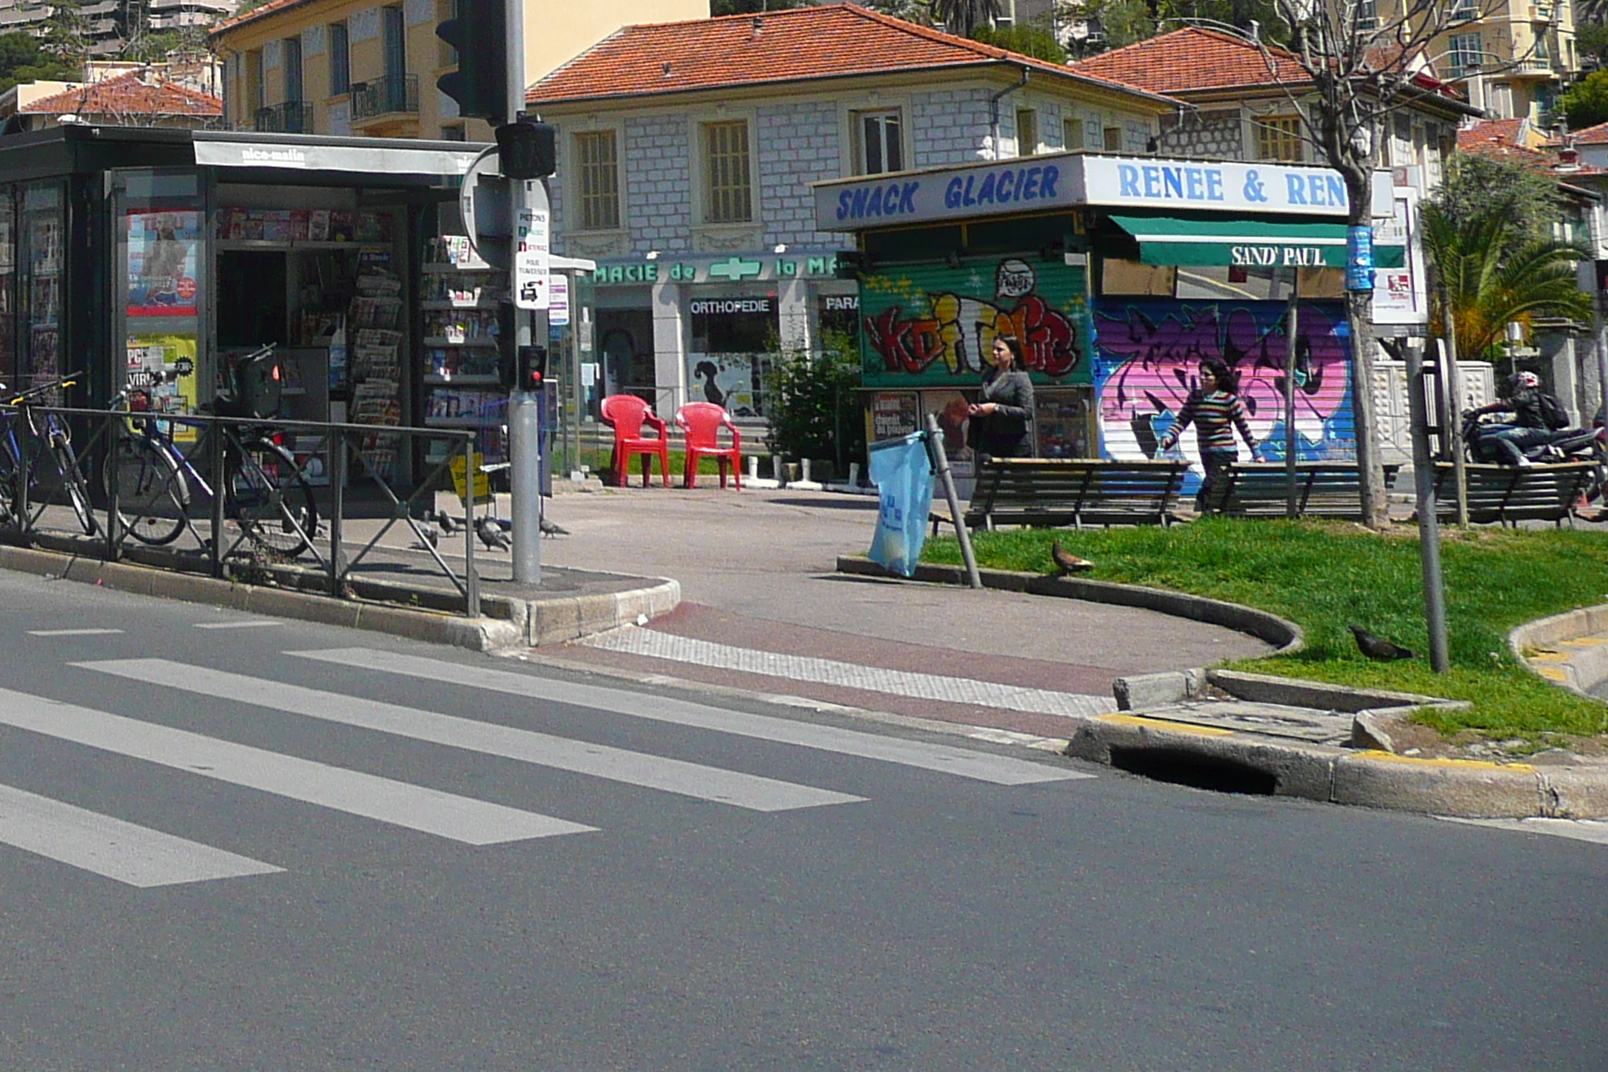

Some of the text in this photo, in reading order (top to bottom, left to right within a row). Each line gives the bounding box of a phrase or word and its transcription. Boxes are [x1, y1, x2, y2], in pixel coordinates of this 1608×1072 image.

[836, 165, 1060, 221] SNACK GLACIER
[1117, 164, 1346, 207] RENEE & REN
[1283, 247, 1327, 267] PAUL
[670, 262, 694, 280] de
[776, 259, 797, 275] la
[691, 297, 859, 315] ORTHOPEDIE PARA
